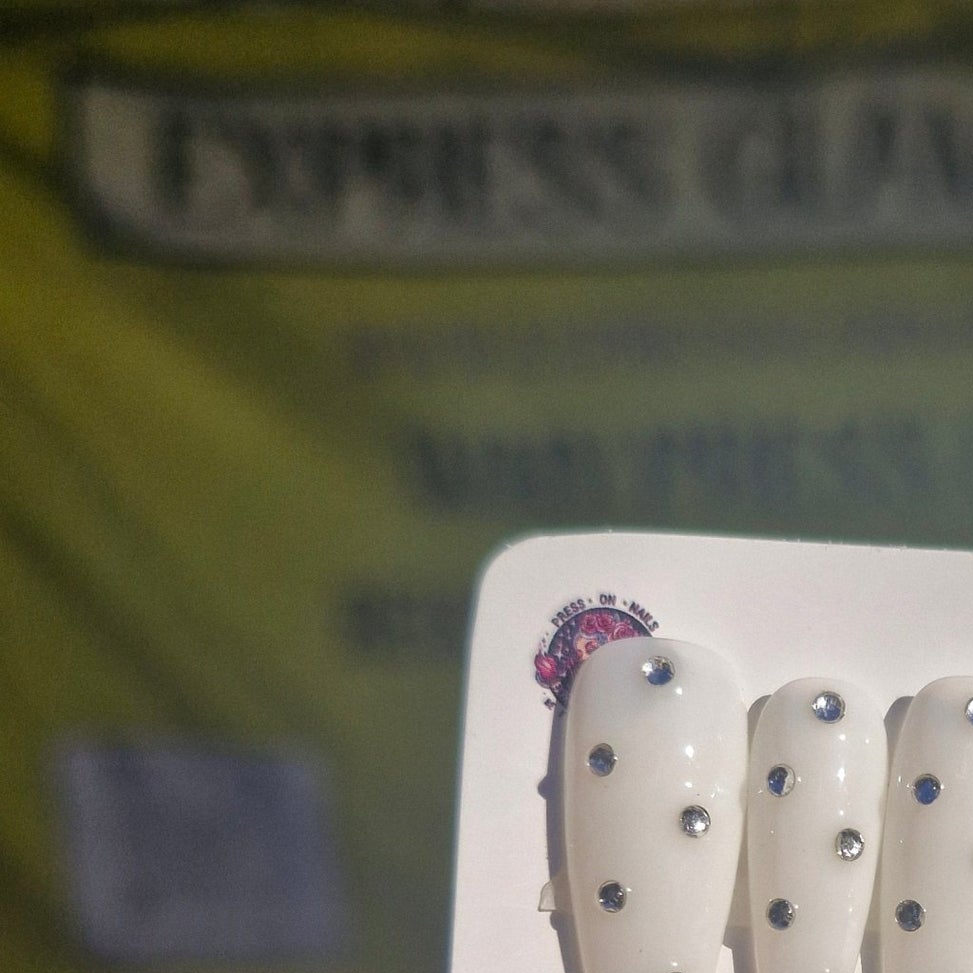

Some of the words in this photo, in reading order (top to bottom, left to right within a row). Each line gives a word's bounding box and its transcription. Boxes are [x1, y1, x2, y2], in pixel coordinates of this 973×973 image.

[552, 599, 586, 627] PRESS
[599, 594, 617, 606] ON
[629, 603, 660, 631] NAILS
